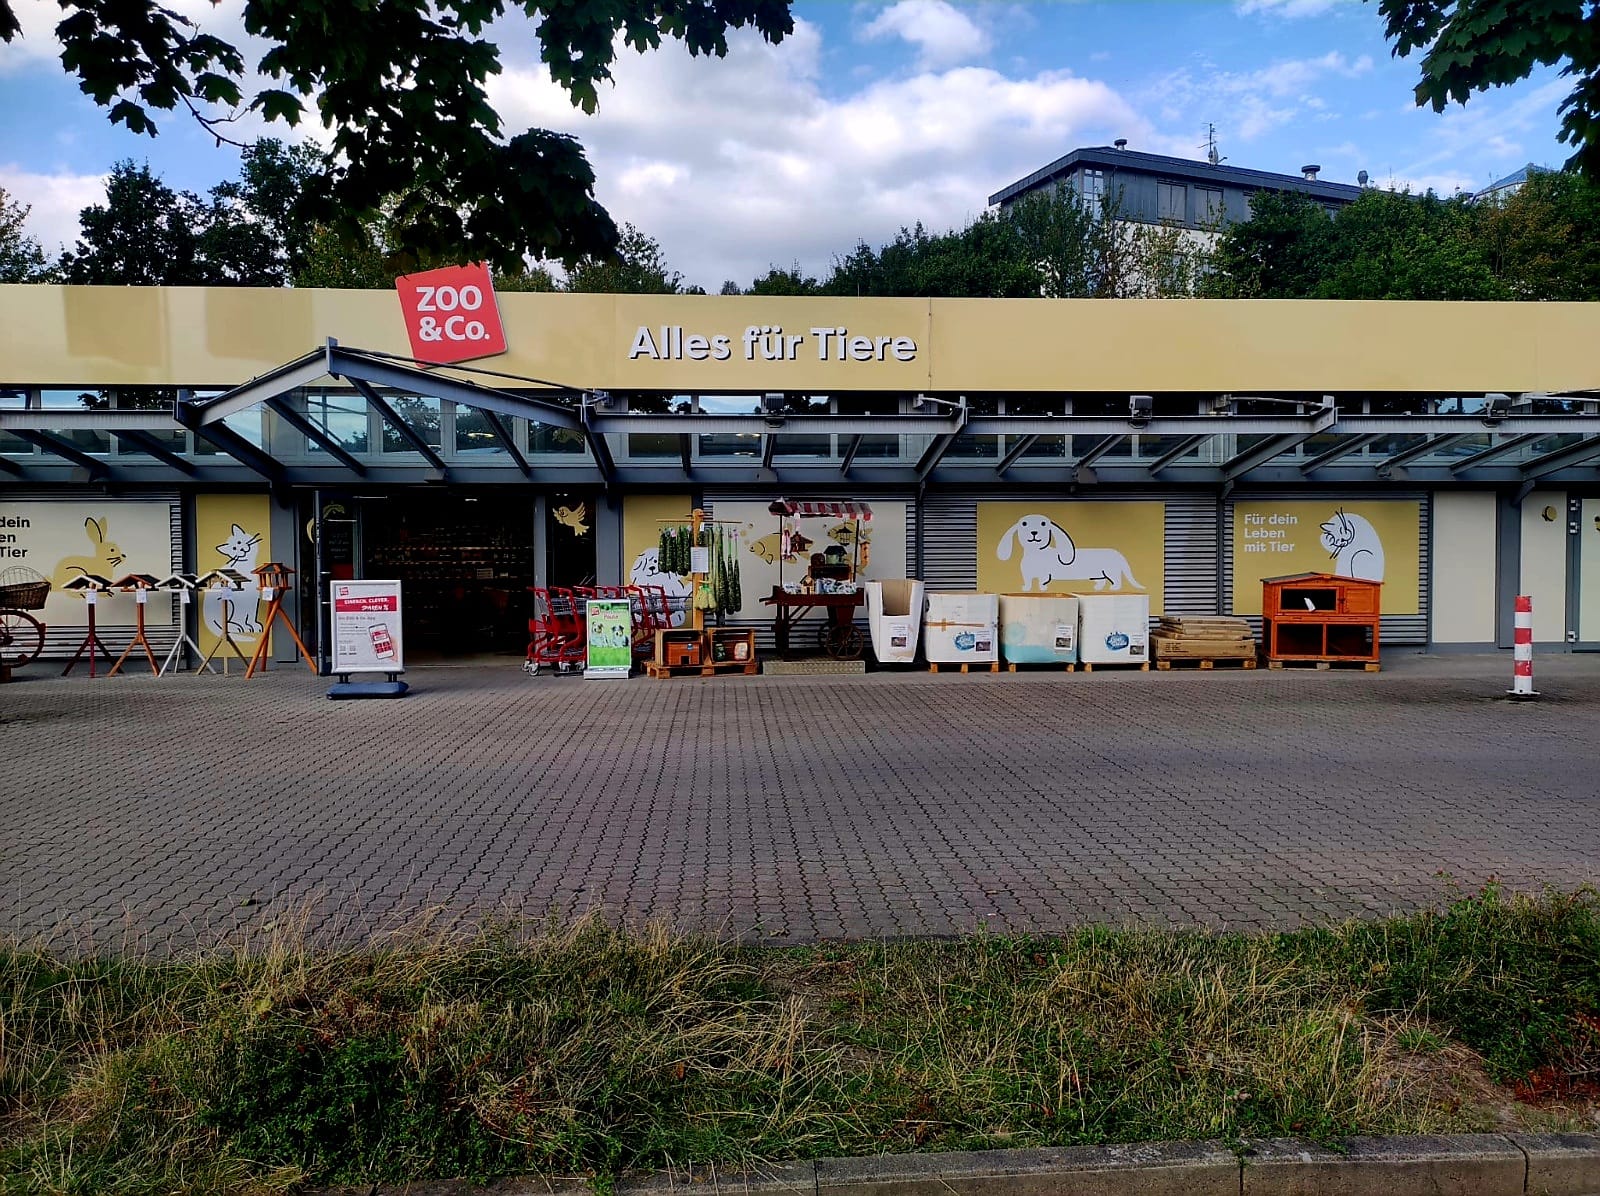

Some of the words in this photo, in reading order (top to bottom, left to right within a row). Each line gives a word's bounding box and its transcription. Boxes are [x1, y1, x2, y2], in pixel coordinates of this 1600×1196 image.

[416, 285, 483, 312] ZOO
[628, 325, 732, 361] Alles
[743, 325, 804, 361] für
[810, 326, 918, 362] Tiere
[0, 516, 30, 528] dein
[1244, 513, 1266, 524] Für
[1268, 514, 1298, 524] dein
[1244, 528, 1286, 538] Leben
[0, 546, 28, 558] Tier
[1244, 541, 1266, 552] mit
[1268, 541, 1295, 552] Tier
